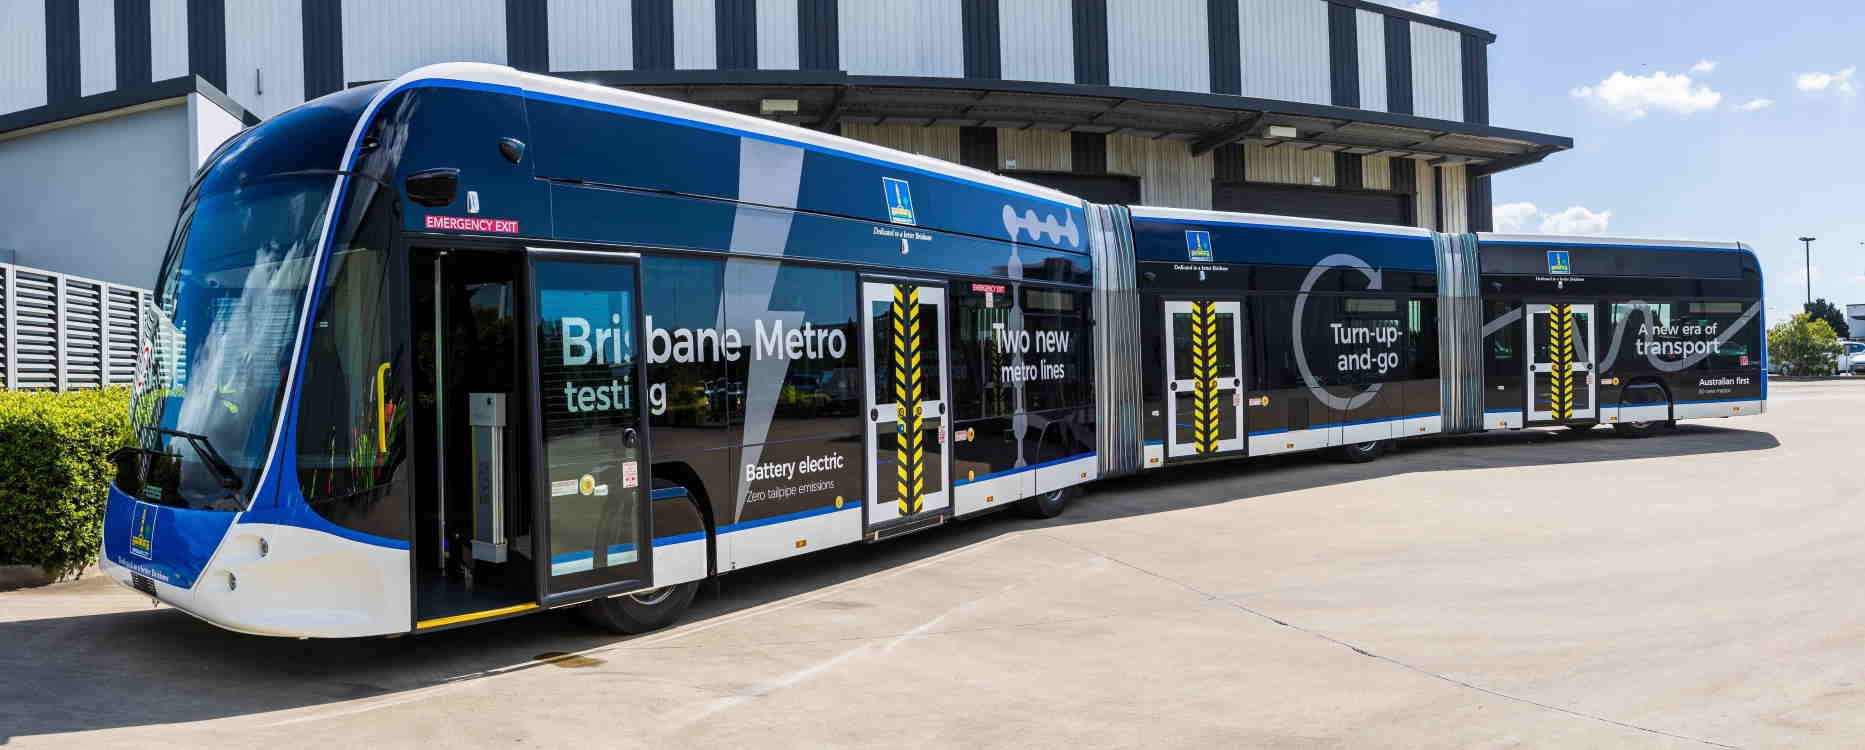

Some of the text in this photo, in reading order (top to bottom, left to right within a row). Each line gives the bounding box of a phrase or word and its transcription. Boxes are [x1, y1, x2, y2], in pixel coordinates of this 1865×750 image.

[426, 216, 518, 233] EMERGENCY EXIT
[755, 319, 847, 361] Metro
[992, 322, 1070, 354] Two new
[1329, 322, 1403, 348] Turn-up-
[1638, 322, 1718, 335] A new era of
[1337, 347, 1399, 374] and-go
[1635, 338, 1721, 359] transport
[1001, 359, 1065, 383] metro lines
[1699, 376, 1751, 386] Australian first
[564, 376, 667, 416] testig
[745, 452, 845, 482] Battery electric
[744, 480, 835, 503] Zero tailpipe emissions
